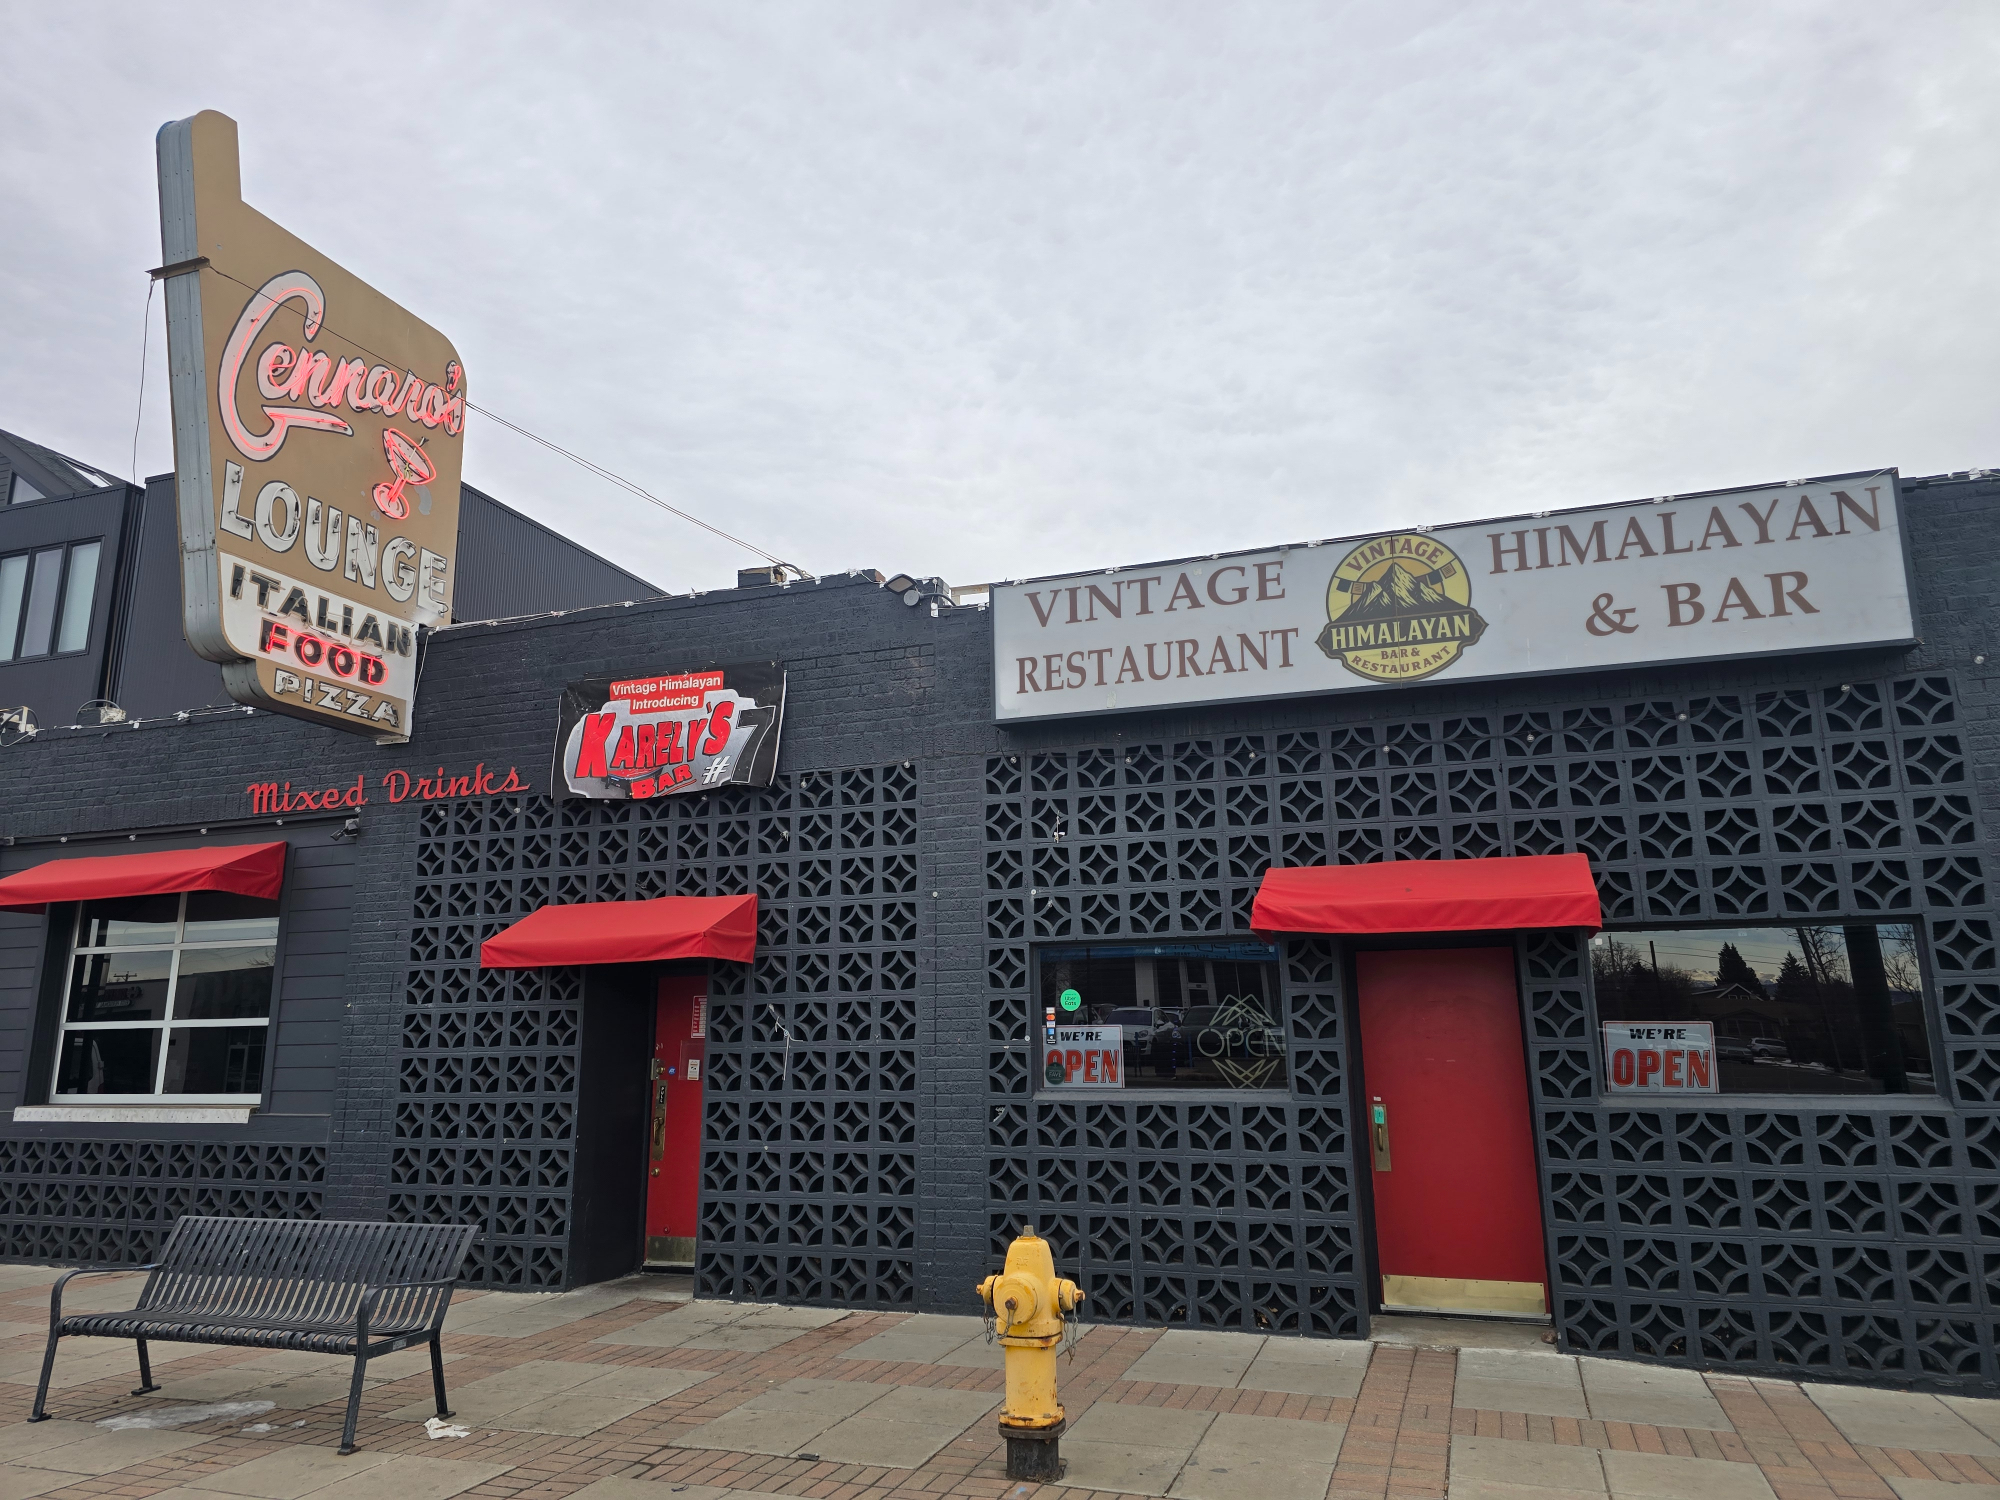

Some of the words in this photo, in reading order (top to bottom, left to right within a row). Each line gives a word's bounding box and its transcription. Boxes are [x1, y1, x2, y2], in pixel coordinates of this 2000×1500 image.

[218, 270, 464, 462] Gennaro's
[219, 459, 448, 618] LOUNGE
[1024, 560, 1286, 628] VINTAGE
[1486, 486, 1881, 575] HIMALAYAN
[1346, 538, 1443, 570] VINTAGE
[229, 562, 412, 657] ITALIAN
[258, 616, 389, 686] FOOD
[1016, 627, 1299, 694] RESTAURANT
[1584, 592, 1640, 637] &
[1660, 570, 1820, 628] BAR
[1331, 614, 1470, 649] HIMALAYAN
[1352, 646, 1450, 673] RESTAURANT
[273, 667, 400, 729] PIZZA
[612, 681, 657, 696] Vintage
[659, 676, 721, 692] Himalayan
[632, 694, 699, 710] Introducing
[574, 701, 735, 778] KARELY'S
[247, 774, 369, 814] Mixed
[382, 763, 530, 803] Drinks
[630, 763, 693, 800] BAR
[1060, 1030, 1103, 1042] WE'RE
[1196, 1027, 1287, 1058] OPEN
[1629, 1028, 1687, 1040] WE'RE
[1612, 1048, 1710, 1088] OPEN
